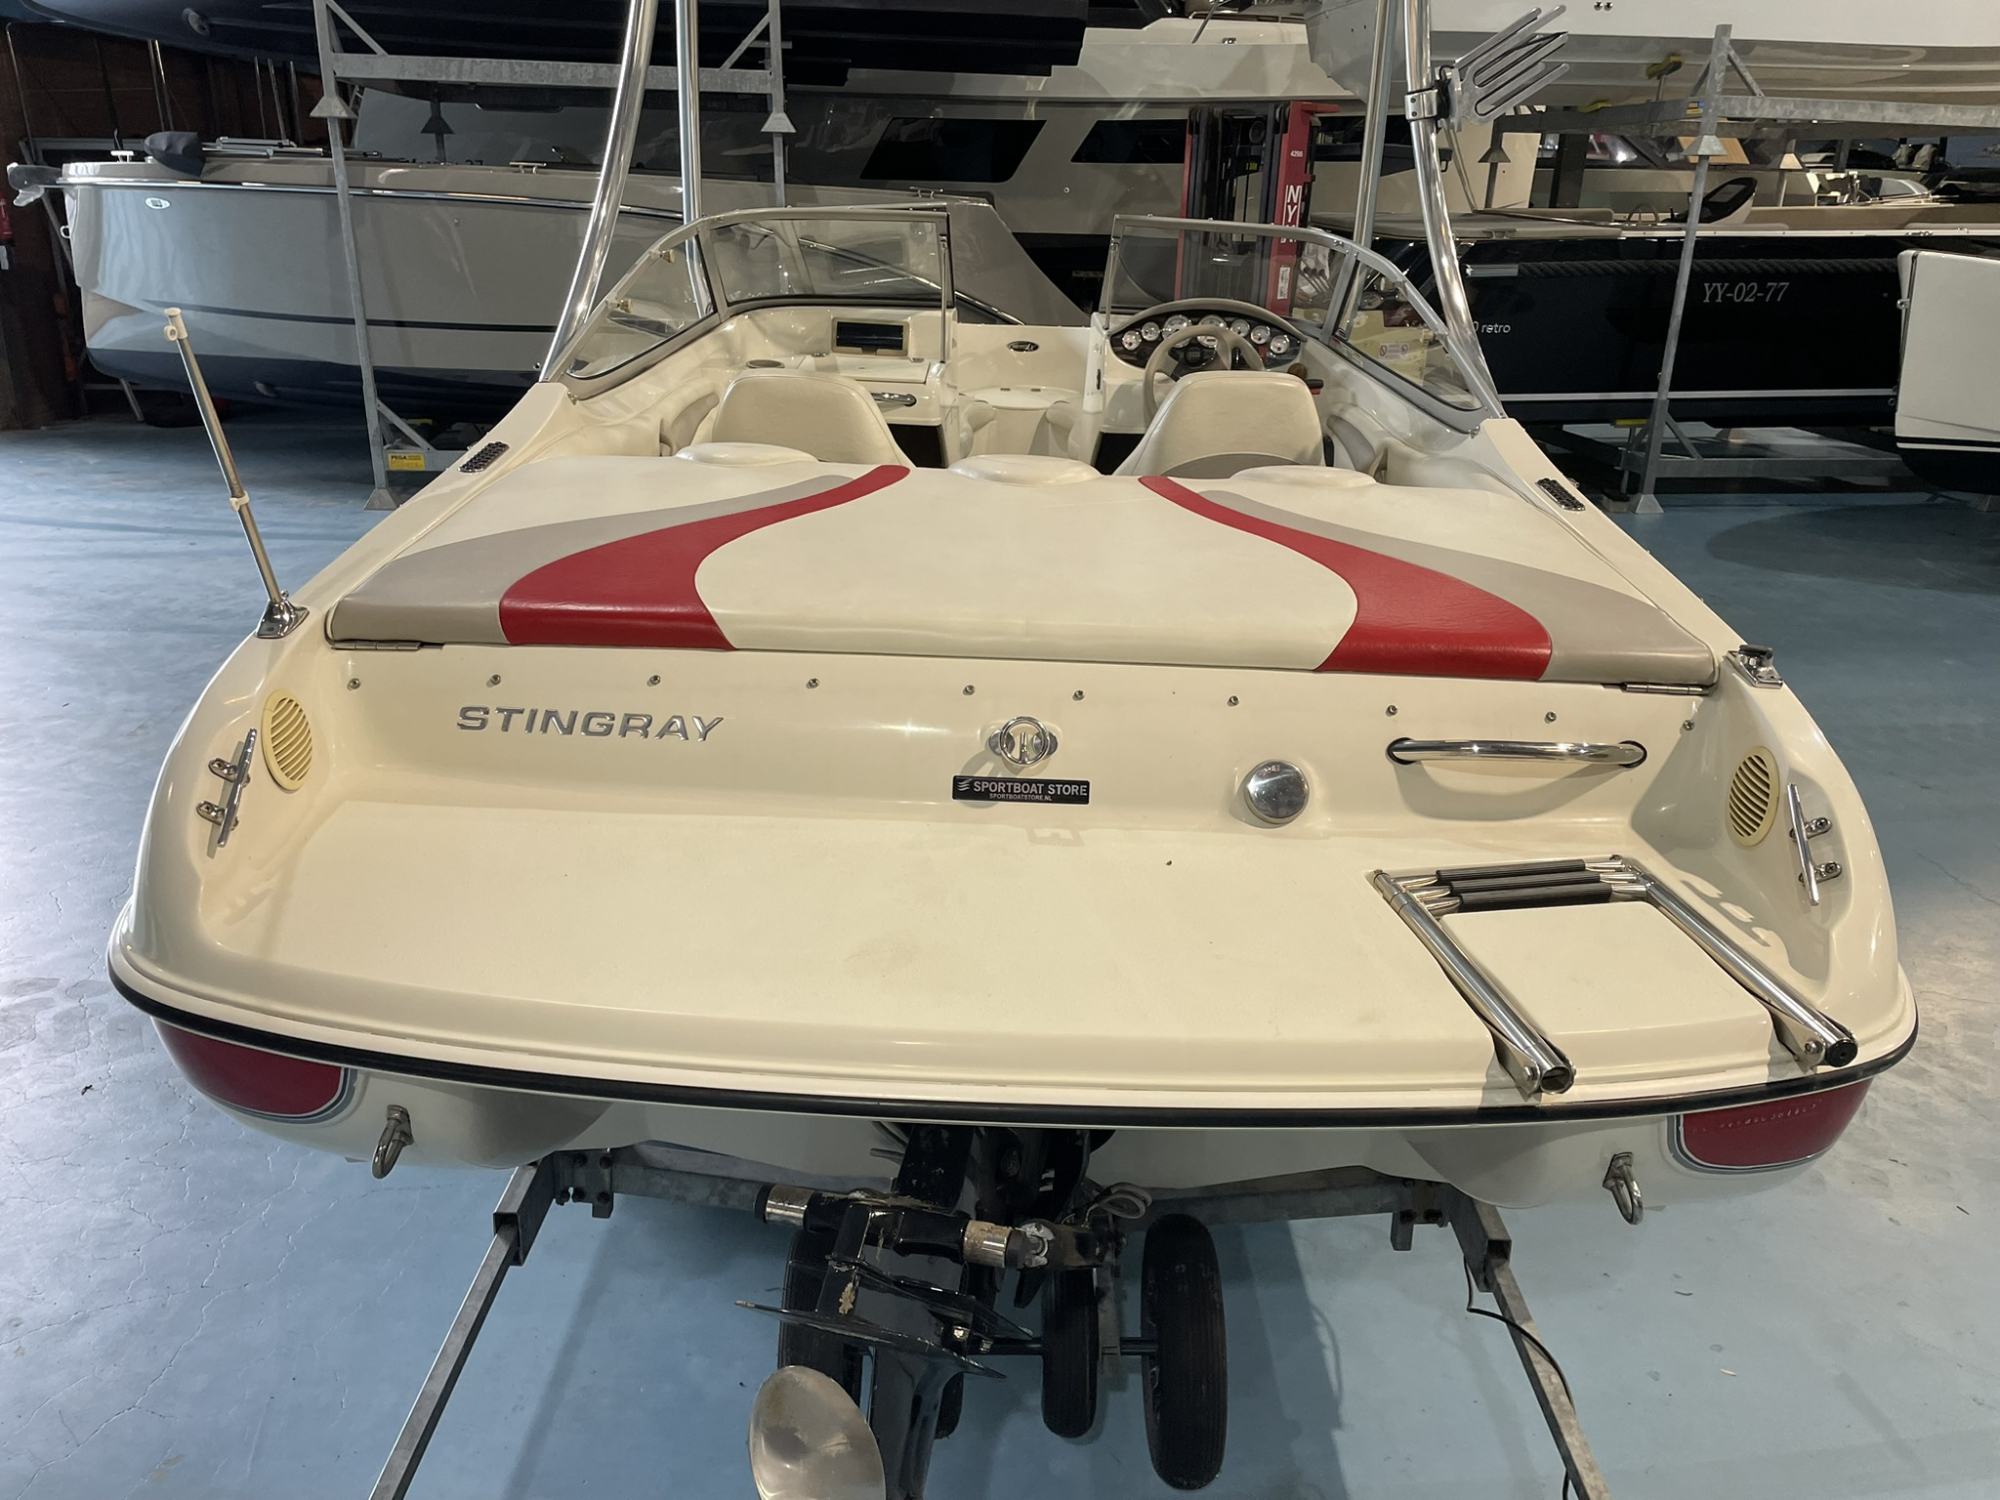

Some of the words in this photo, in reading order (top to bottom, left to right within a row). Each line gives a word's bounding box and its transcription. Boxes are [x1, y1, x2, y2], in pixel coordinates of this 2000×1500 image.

[1703, 282, 1789, 303] YY-02-77
[1481, 322, 1512, 334] retro
[456, 706, 724, 741] STINGRAY
[973, 781, 1045, 794] SPORTBOAT
[1047, 783, 1088, 796] STORE
[989, 793, 1052, 802] SPORTBOATSTORE.NL
